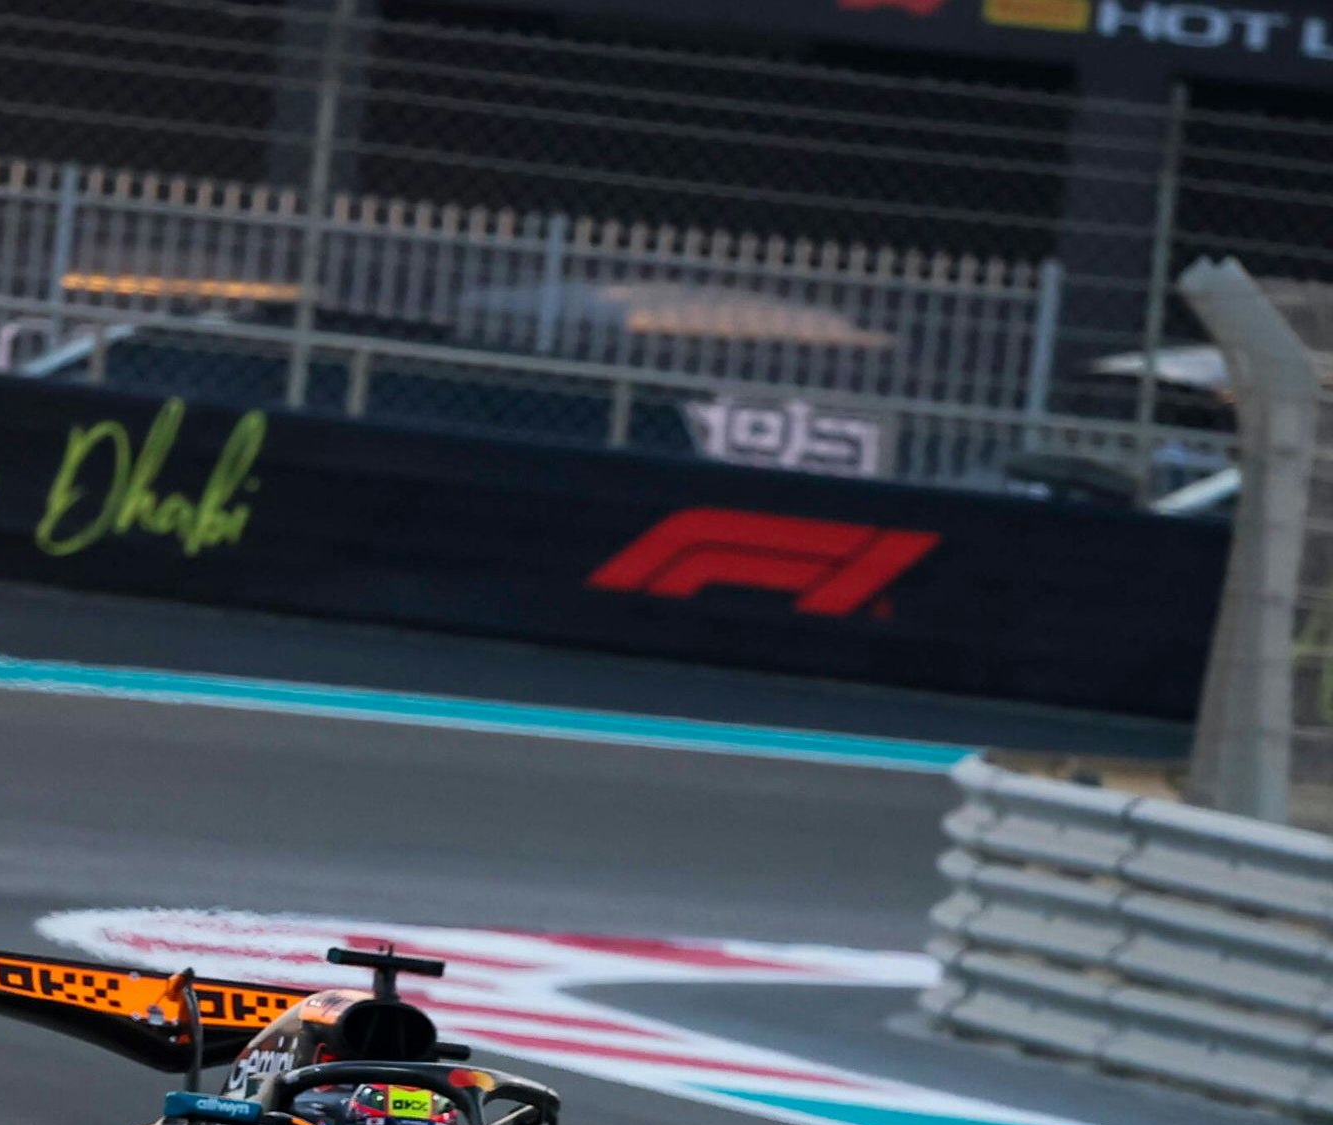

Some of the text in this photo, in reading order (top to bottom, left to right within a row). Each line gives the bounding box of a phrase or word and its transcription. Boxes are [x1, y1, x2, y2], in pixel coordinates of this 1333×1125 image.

[1095, 0, 1290, 52] HOT
[35, 398, 265, 556] Dhabi
[587, 508, 941, 616] F1
